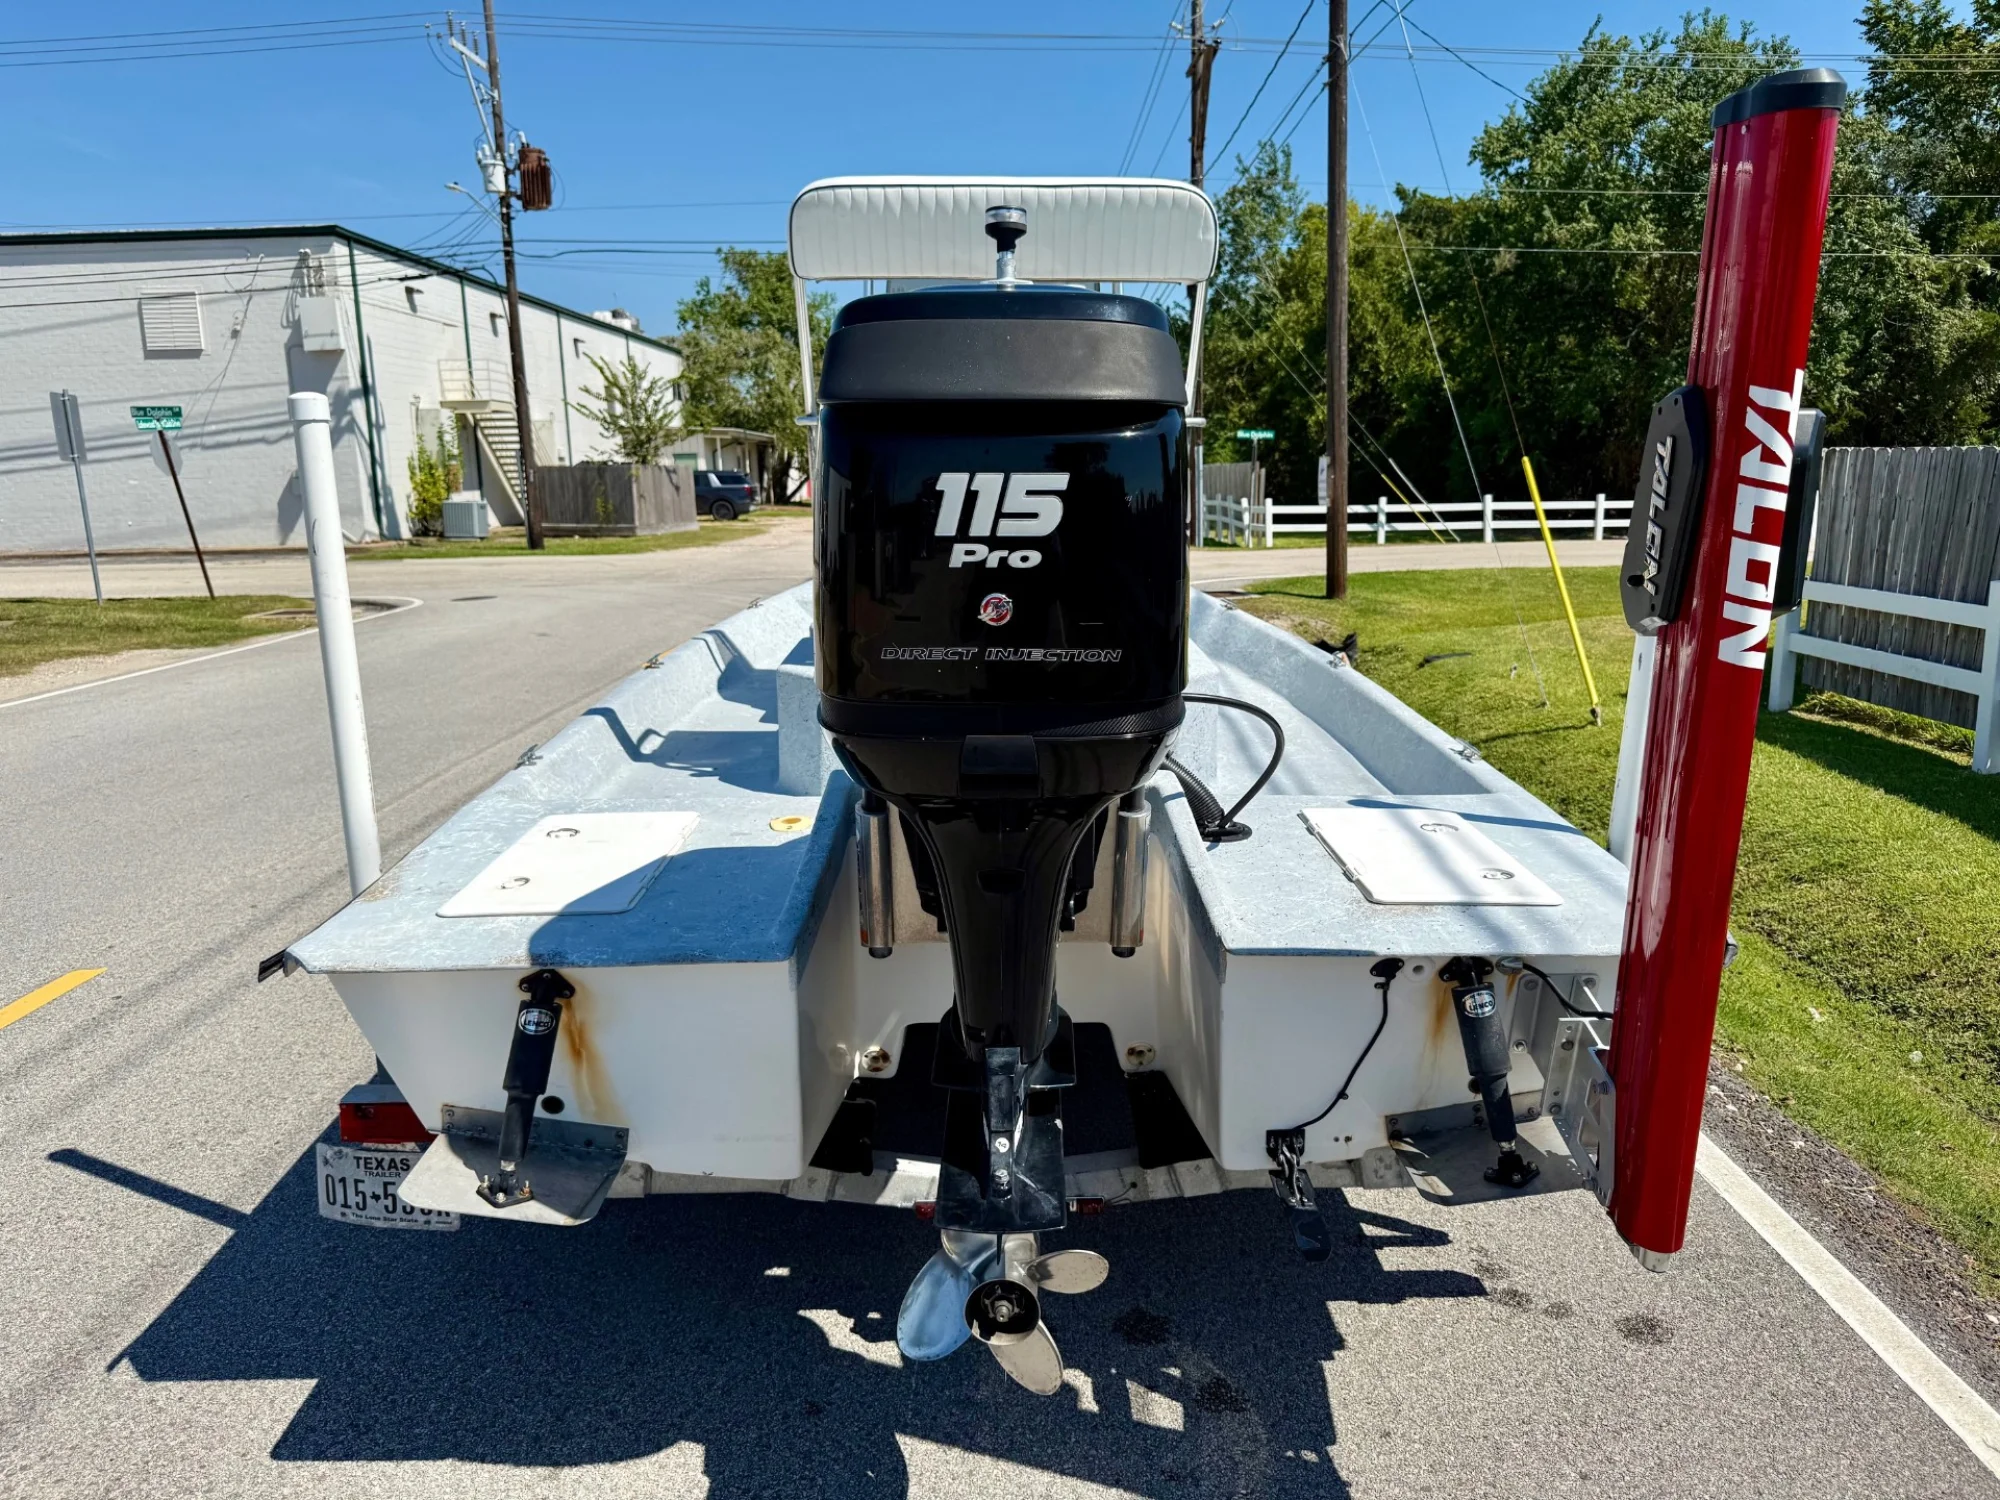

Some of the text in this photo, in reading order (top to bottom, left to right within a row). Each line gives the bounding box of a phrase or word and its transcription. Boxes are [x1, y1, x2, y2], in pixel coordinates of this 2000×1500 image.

[131, 407, 145, 417] Blue
[146, 407, 173, 418] Dolphin
[934, 472, 1070, 537] 115
[1718, 368, 1804, 670] TALON
[948, 543, 1043, 569] Pro
[880, 647, 1123, 663] DIRECT INJECTION
[353, 1156, 411, 1172] TEXAS
[364, 1170, 402, 1178] TRAILER
[351, 1211, 363, 1219] The
